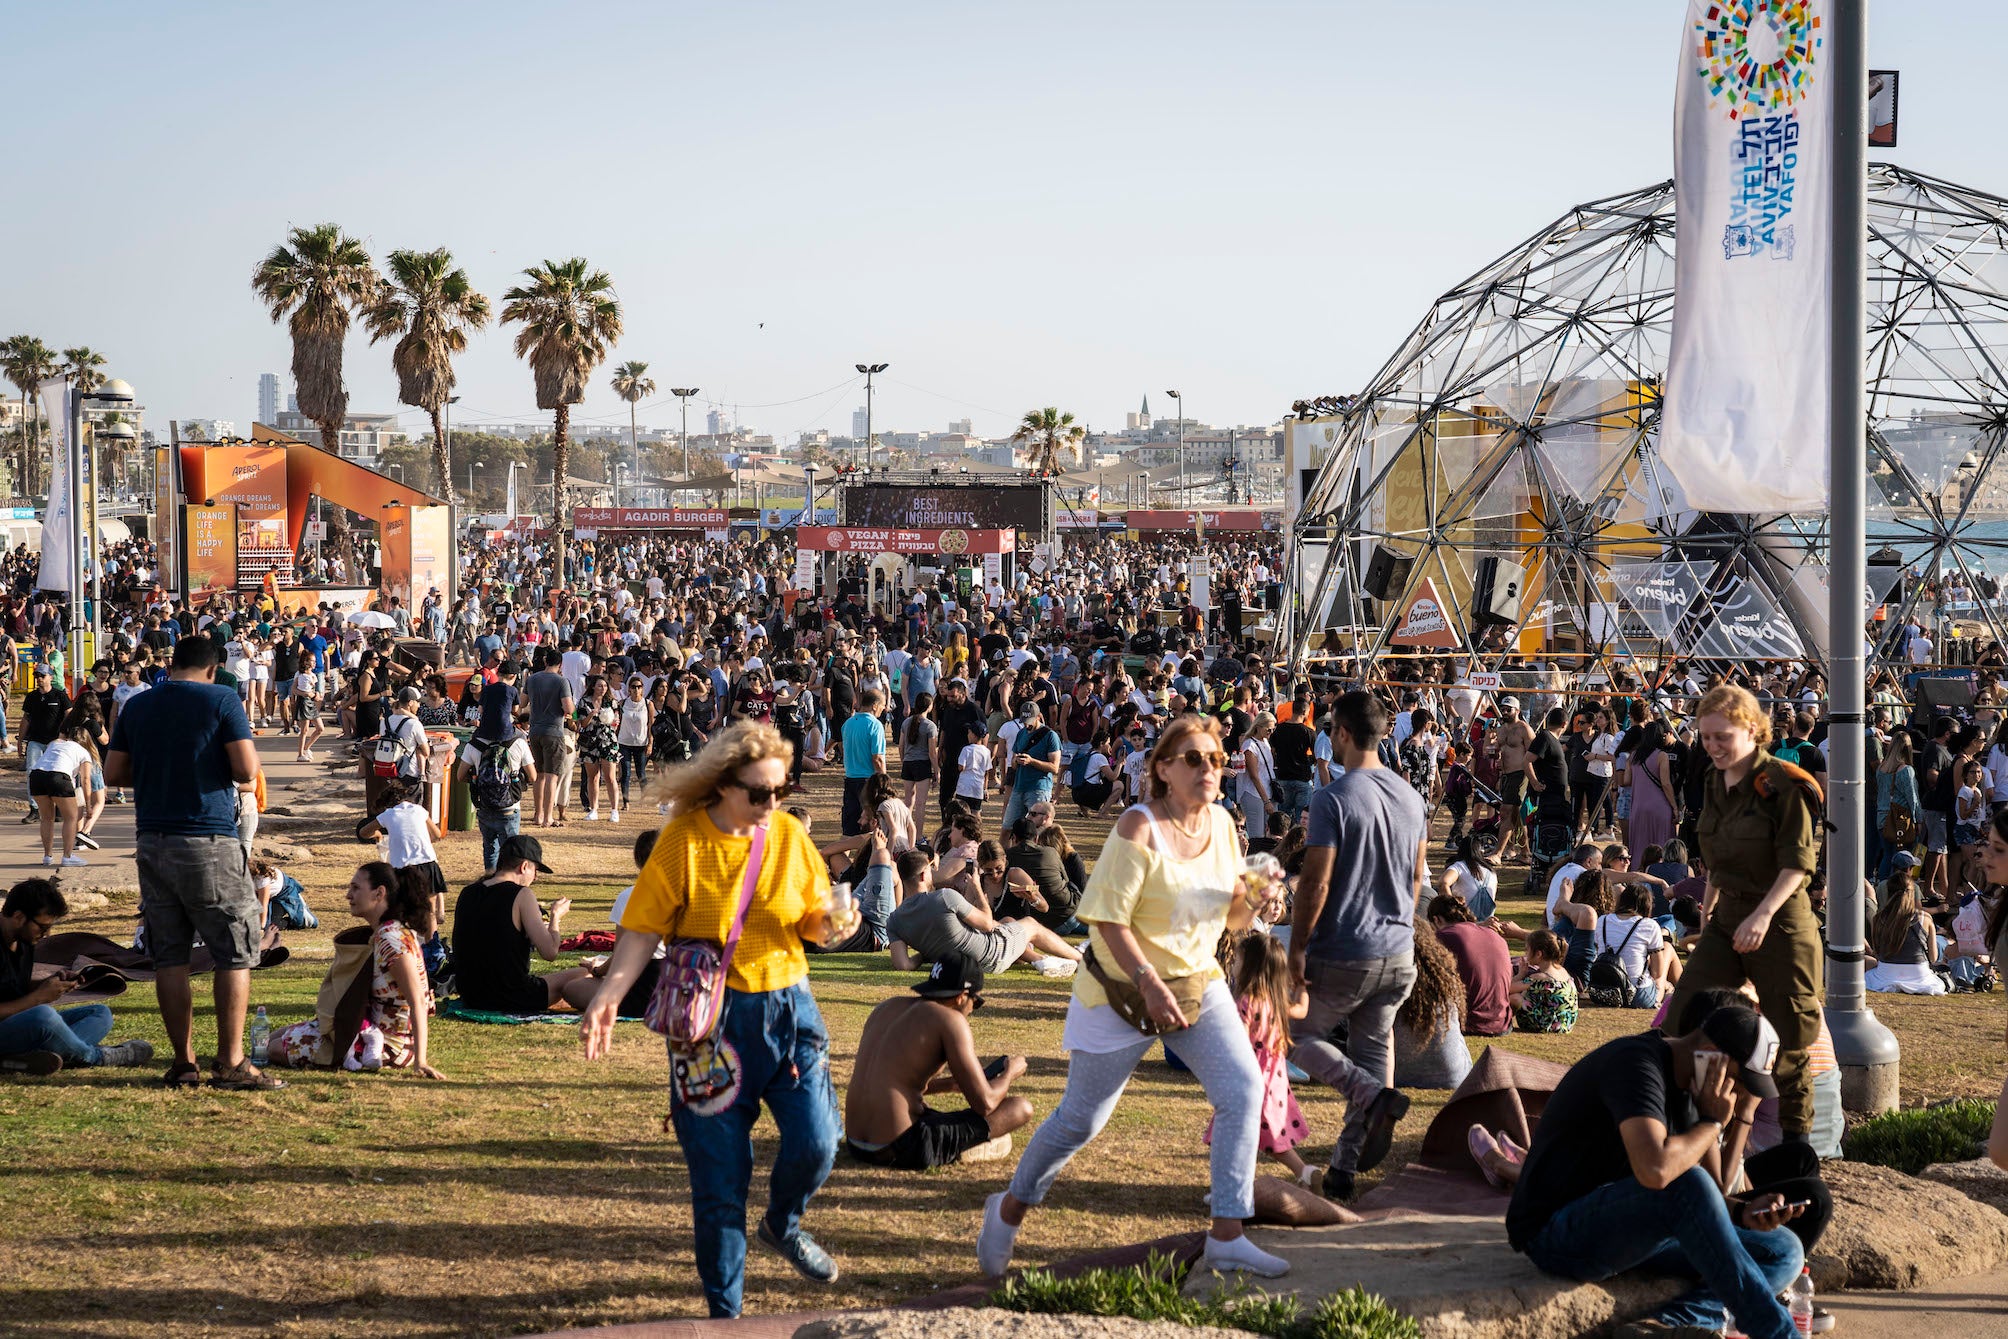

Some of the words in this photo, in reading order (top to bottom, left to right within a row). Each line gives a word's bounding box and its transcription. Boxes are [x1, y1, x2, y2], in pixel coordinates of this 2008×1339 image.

[1785, 113, 1799, 151] יפו
[1739, 118, 1762, 158] תל
[1765, 117, 1782, 183] אביב
[1743, 157, 1762, 205] TEL
[1778, 152, 1797, 219] YAFO
[1762, 184, 1778, 244] AVIV
[232, 464, 261, 476] APEROL
[913, 497, 939, 510] BEST
[196, 511, 227, 520] ORANGE
[624, 512, 670, 522] AGADIR
[674, 512, 724, 522] BURGER
[905, 511, 974, 524] INGREDIENTS
[197, 530, 204, 538] IS
[206, 530, 212, 538] A
[847, 530, 889, 540] VEGAN
[898, 532, 921, 540] פיצה
[197, 539, 223, 547] HAPPY
[850, 540, 885, 550] PIZZA
[898, 542, 935, 550] טבעונית
[197, 548, 213, 556] LIFE
[1409, 609, 1439, 623] bueno
[1472, 676, 1496, 686] כניסה
[746, 701, 769, 710] CATS
